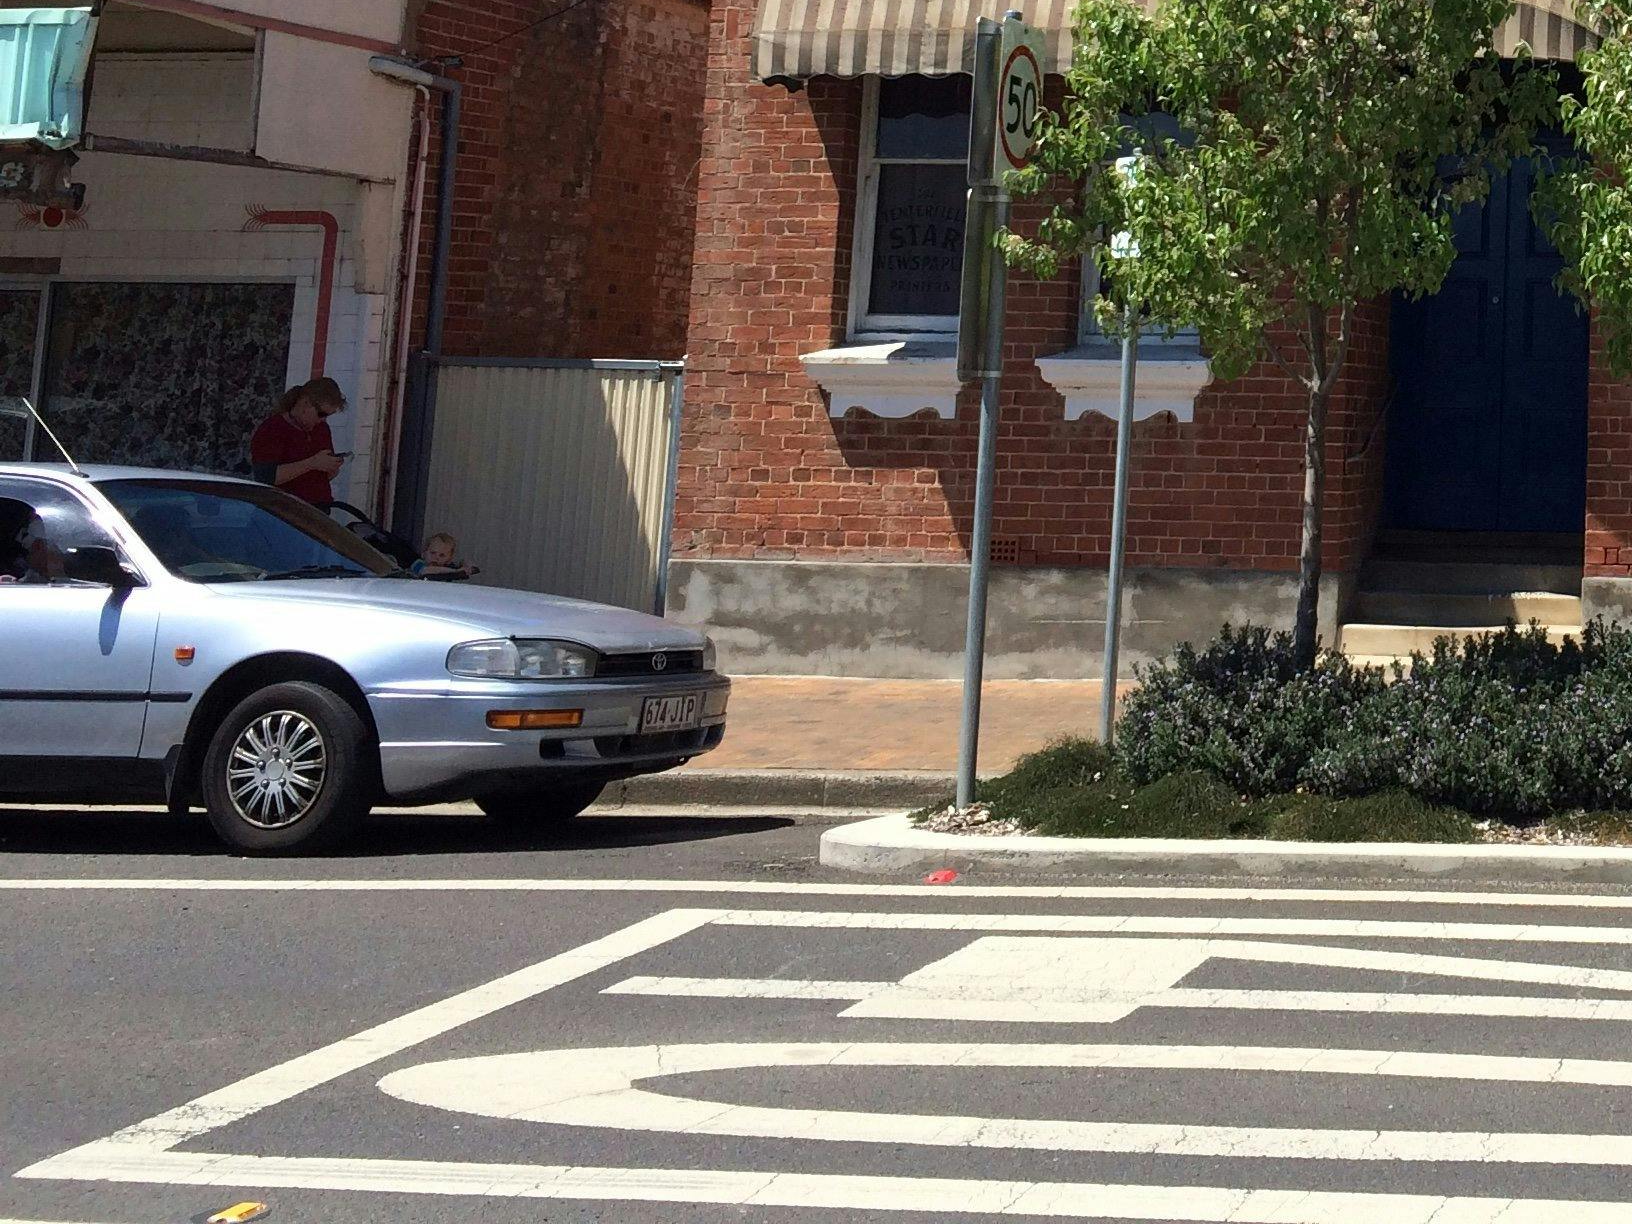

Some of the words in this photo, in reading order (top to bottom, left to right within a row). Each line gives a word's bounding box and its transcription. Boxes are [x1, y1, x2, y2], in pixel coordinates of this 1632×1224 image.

[1006, 75, 1037, 139] 50
[889, 223, 961, 252] STAR
[876, 255, 962, 272] NEWSPAPE
